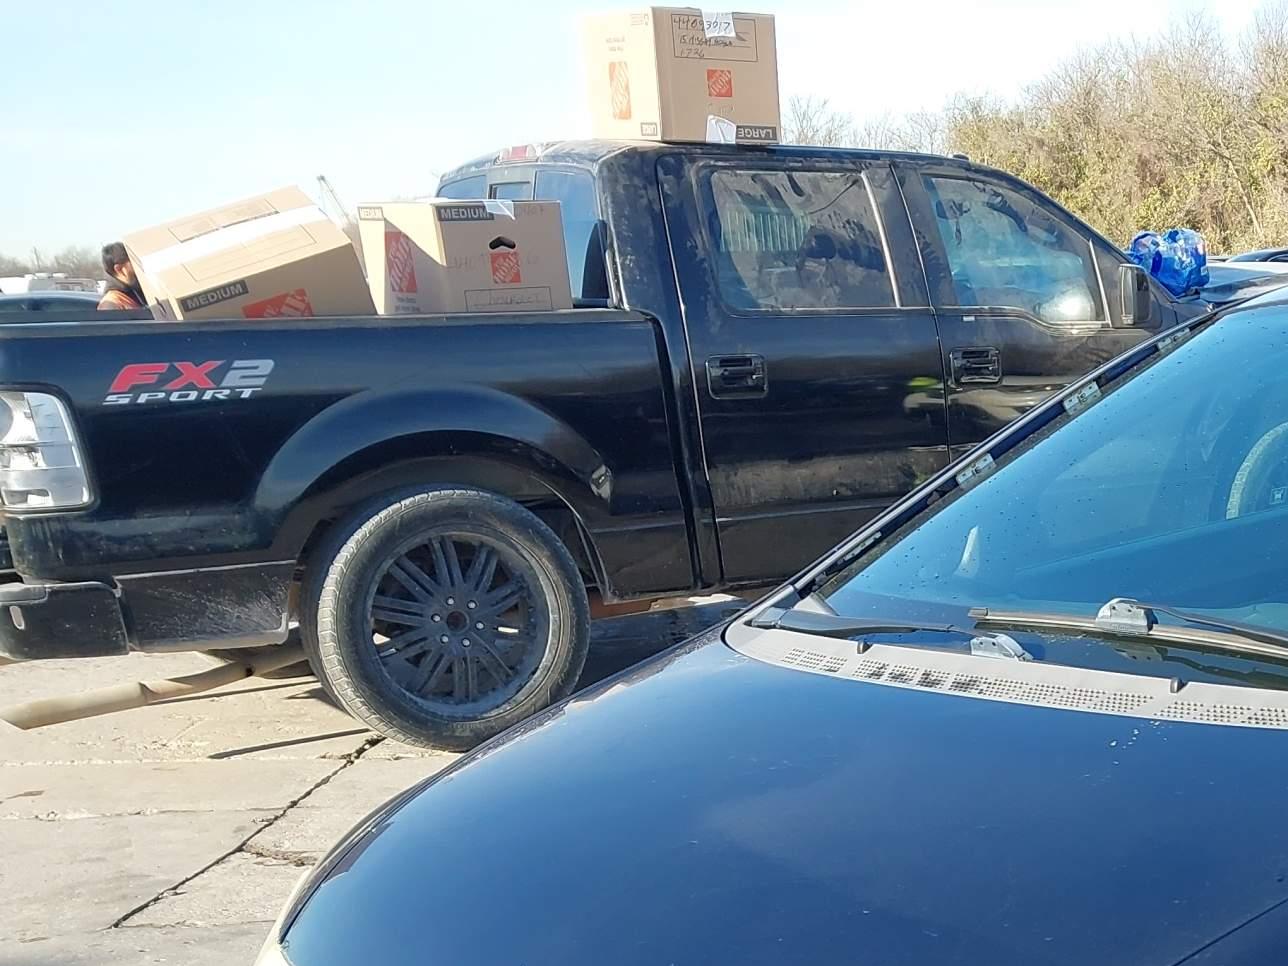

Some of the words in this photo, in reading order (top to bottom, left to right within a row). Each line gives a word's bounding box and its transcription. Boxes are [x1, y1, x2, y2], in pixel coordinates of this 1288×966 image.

[737, 127, 773, 138] LARGE
[440, 207, 490, 219] MEDIUM
[186, 283, 243, 310] MEDIUM
[109, 358, 275, 393] FX2
[103, 387, 263, 405] SPORT
